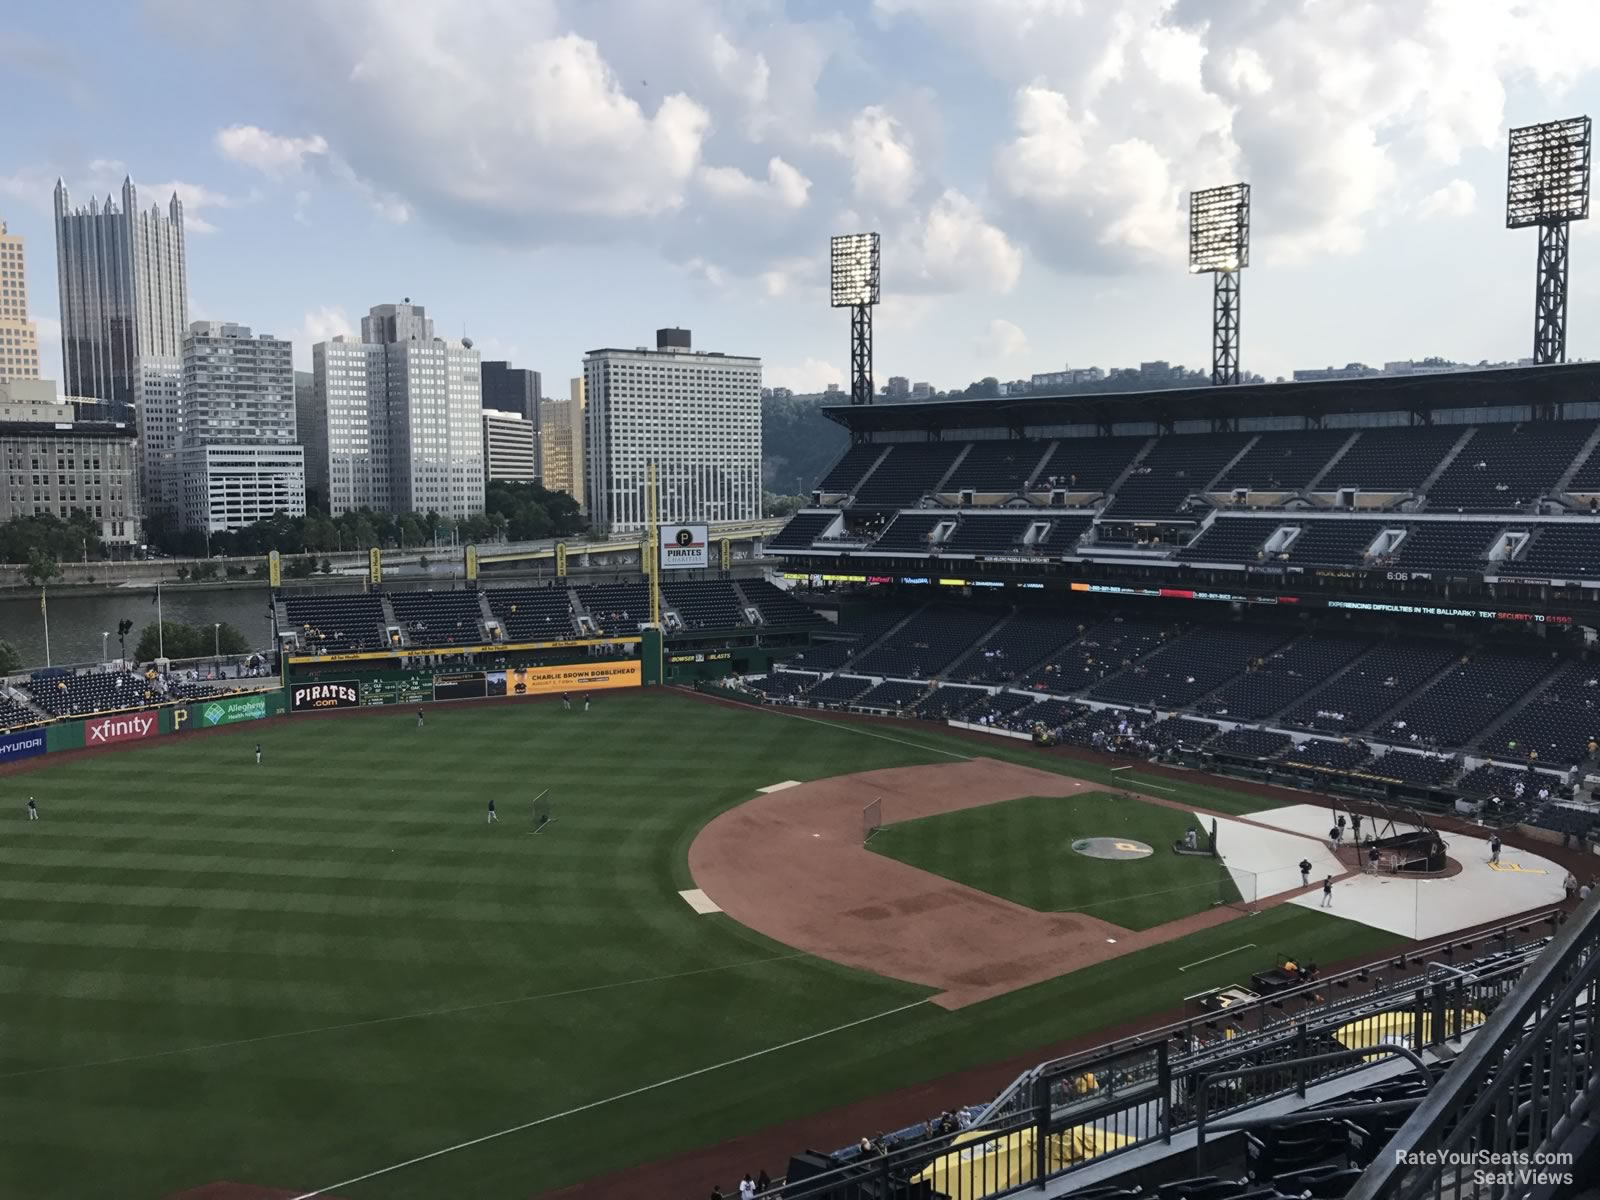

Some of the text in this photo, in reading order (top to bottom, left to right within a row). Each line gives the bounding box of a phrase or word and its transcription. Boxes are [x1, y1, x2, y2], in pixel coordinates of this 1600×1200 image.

[681, 533, 688, 544] P
[1387, 572, 1408, 581] 6:06
[1328, 601, 1372, 610] EXPERIENCING
[1373, 604, 1413, 613] DIFFICULTIES
[591, 668, 635, 676] BOBBLEHEAD
[295, 684, 356, 706] PIRATES
[228, 701, 265, 712] Allegheny
[312, 699, 338, 707] .com
[174, 710, 188, 730] P
[91, 716, 153, 742] xfinity
